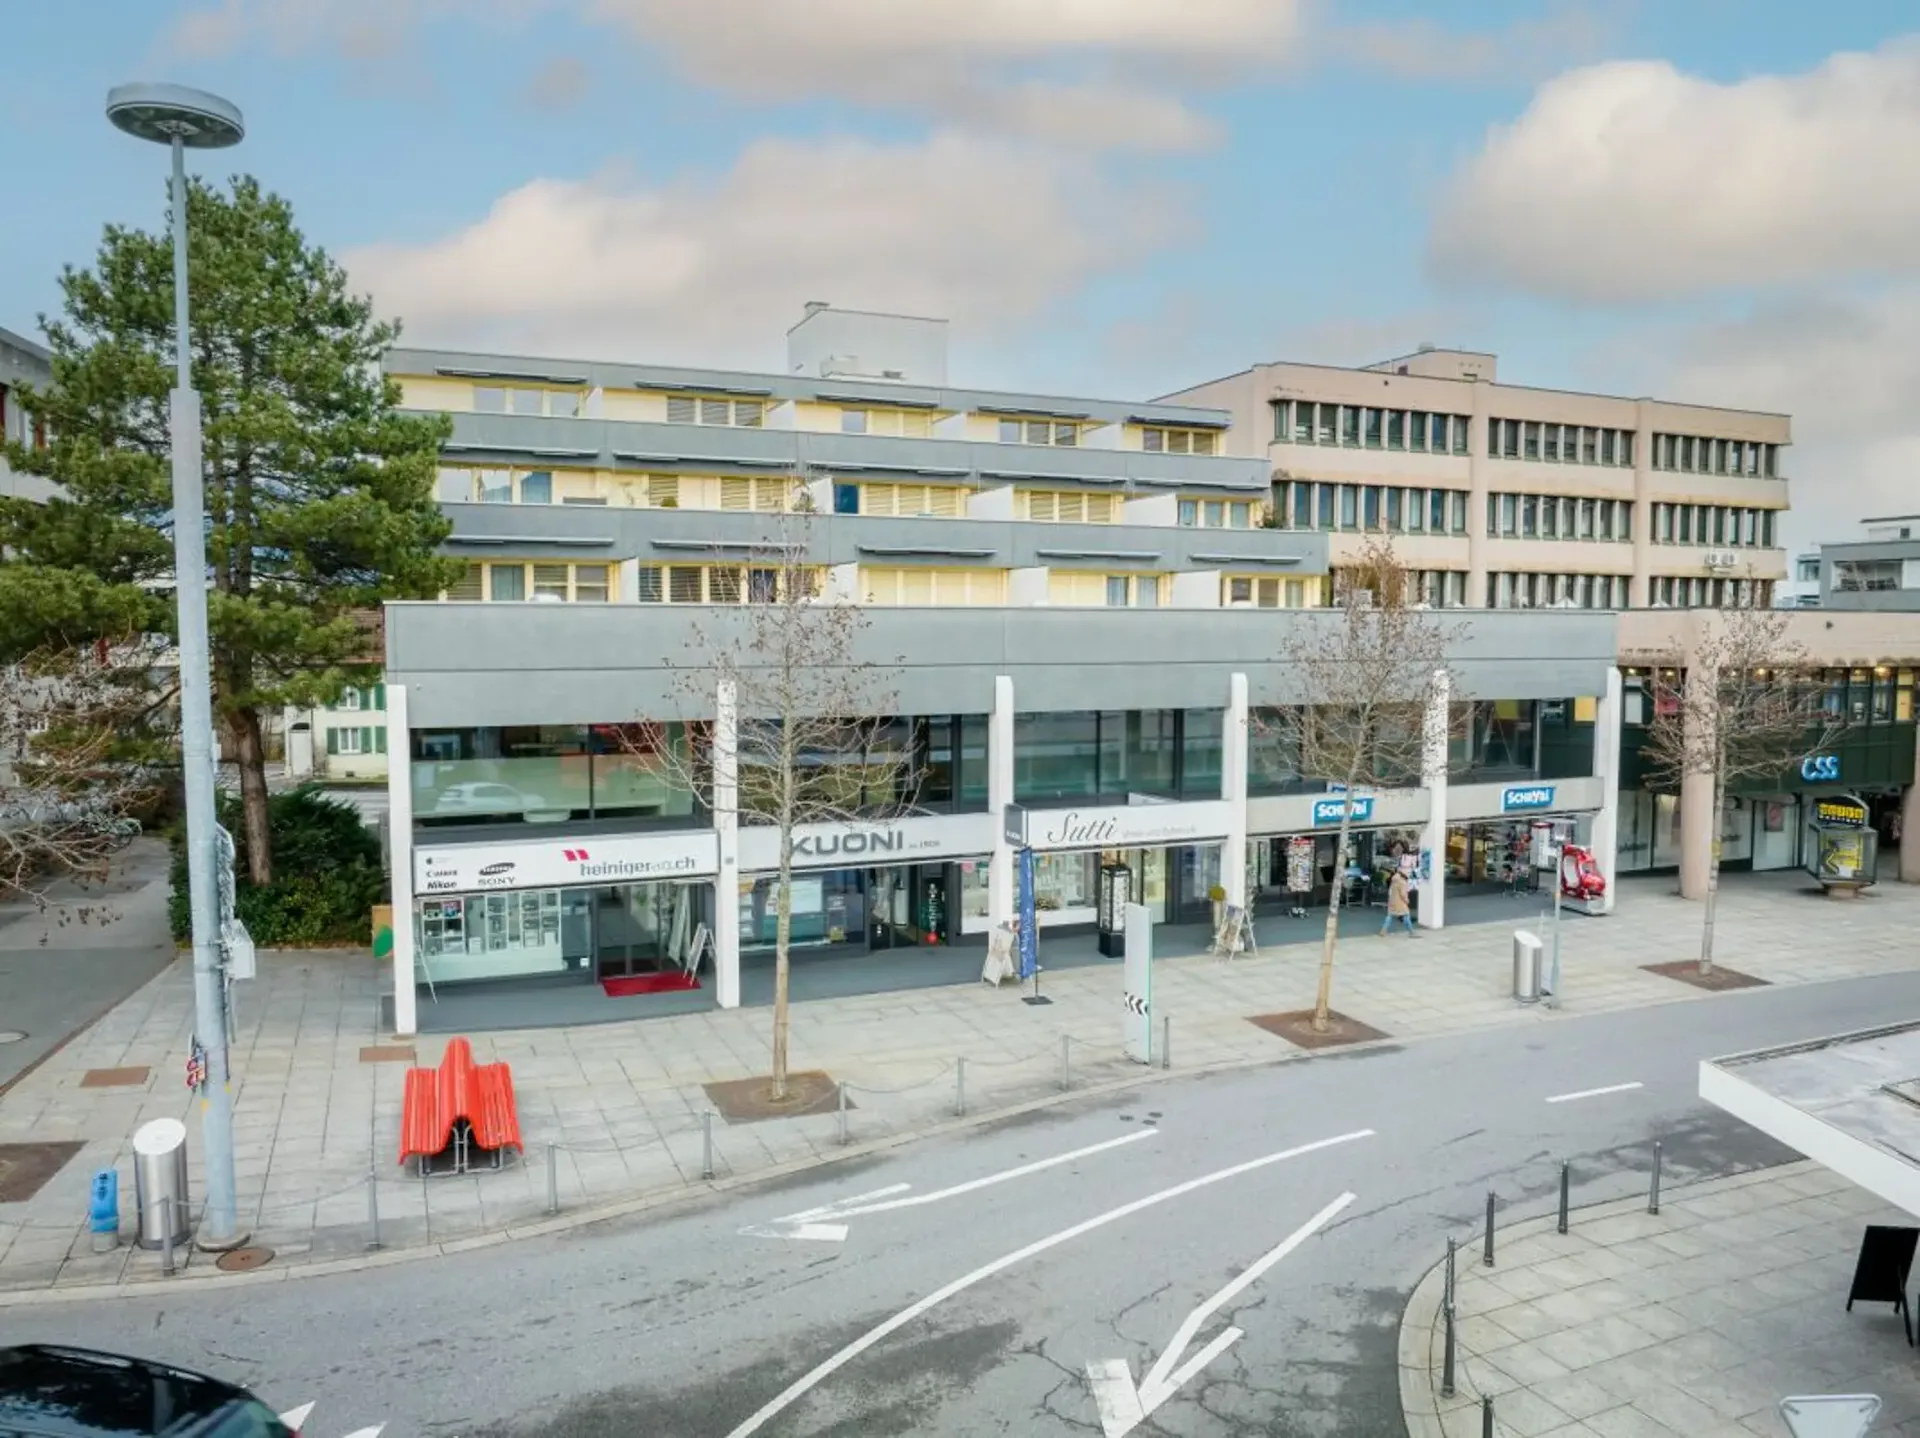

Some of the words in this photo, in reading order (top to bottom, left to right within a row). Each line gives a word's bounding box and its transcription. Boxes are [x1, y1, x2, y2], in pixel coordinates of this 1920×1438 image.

[1801, 756, 1838, 781] CSS
[1048, 812, 1117, 844] Sutti
[791, 829, 903, 856] KUONI
